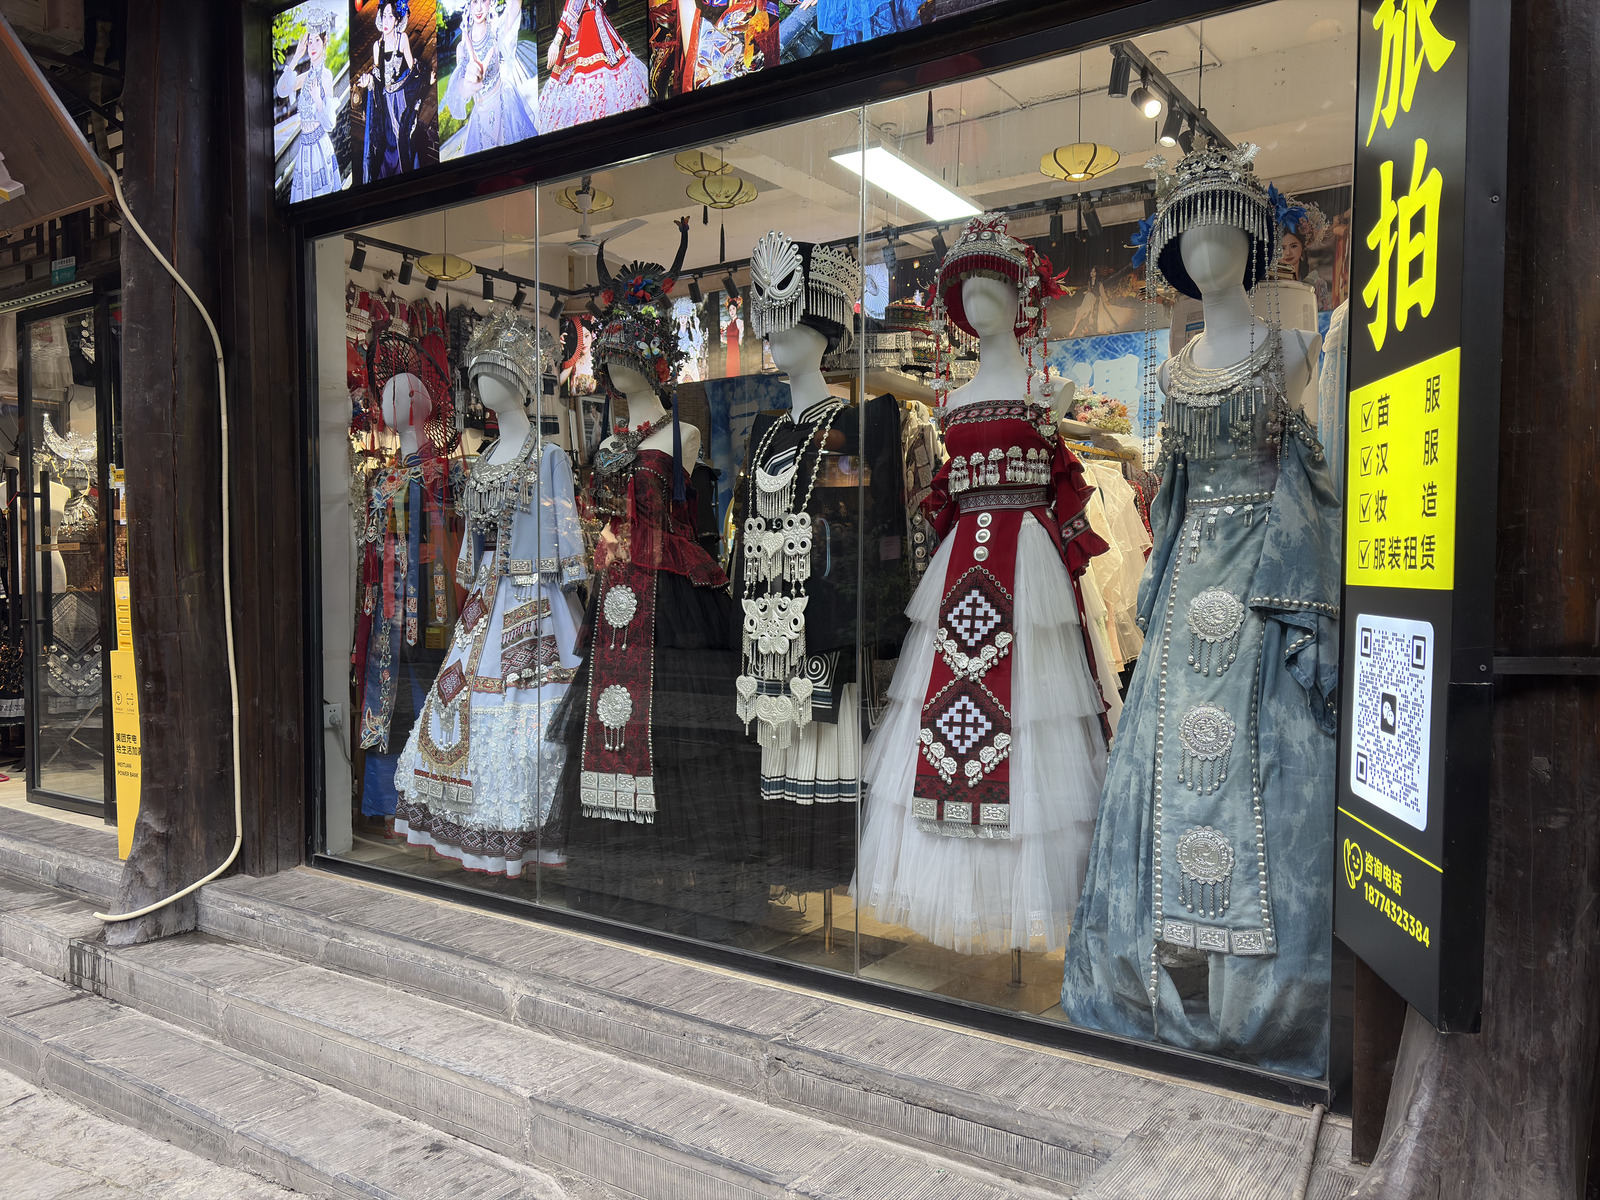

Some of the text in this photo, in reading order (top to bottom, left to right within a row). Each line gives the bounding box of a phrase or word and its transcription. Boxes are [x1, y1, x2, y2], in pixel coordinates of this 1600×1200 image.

[1362, 0, 1456, 352] 旅拍
[1378, 374, 1441, 428] 苗 服
[1376, 428, 1439, 475] 汉 服
[1375, 481, 1437, 522] 妆 造
[1373, 534, 1436, 571] 服装租赁
[1365, 851, 1402, 896] 咨询电话
[1364, 882, 1430, 948] 18774323384
